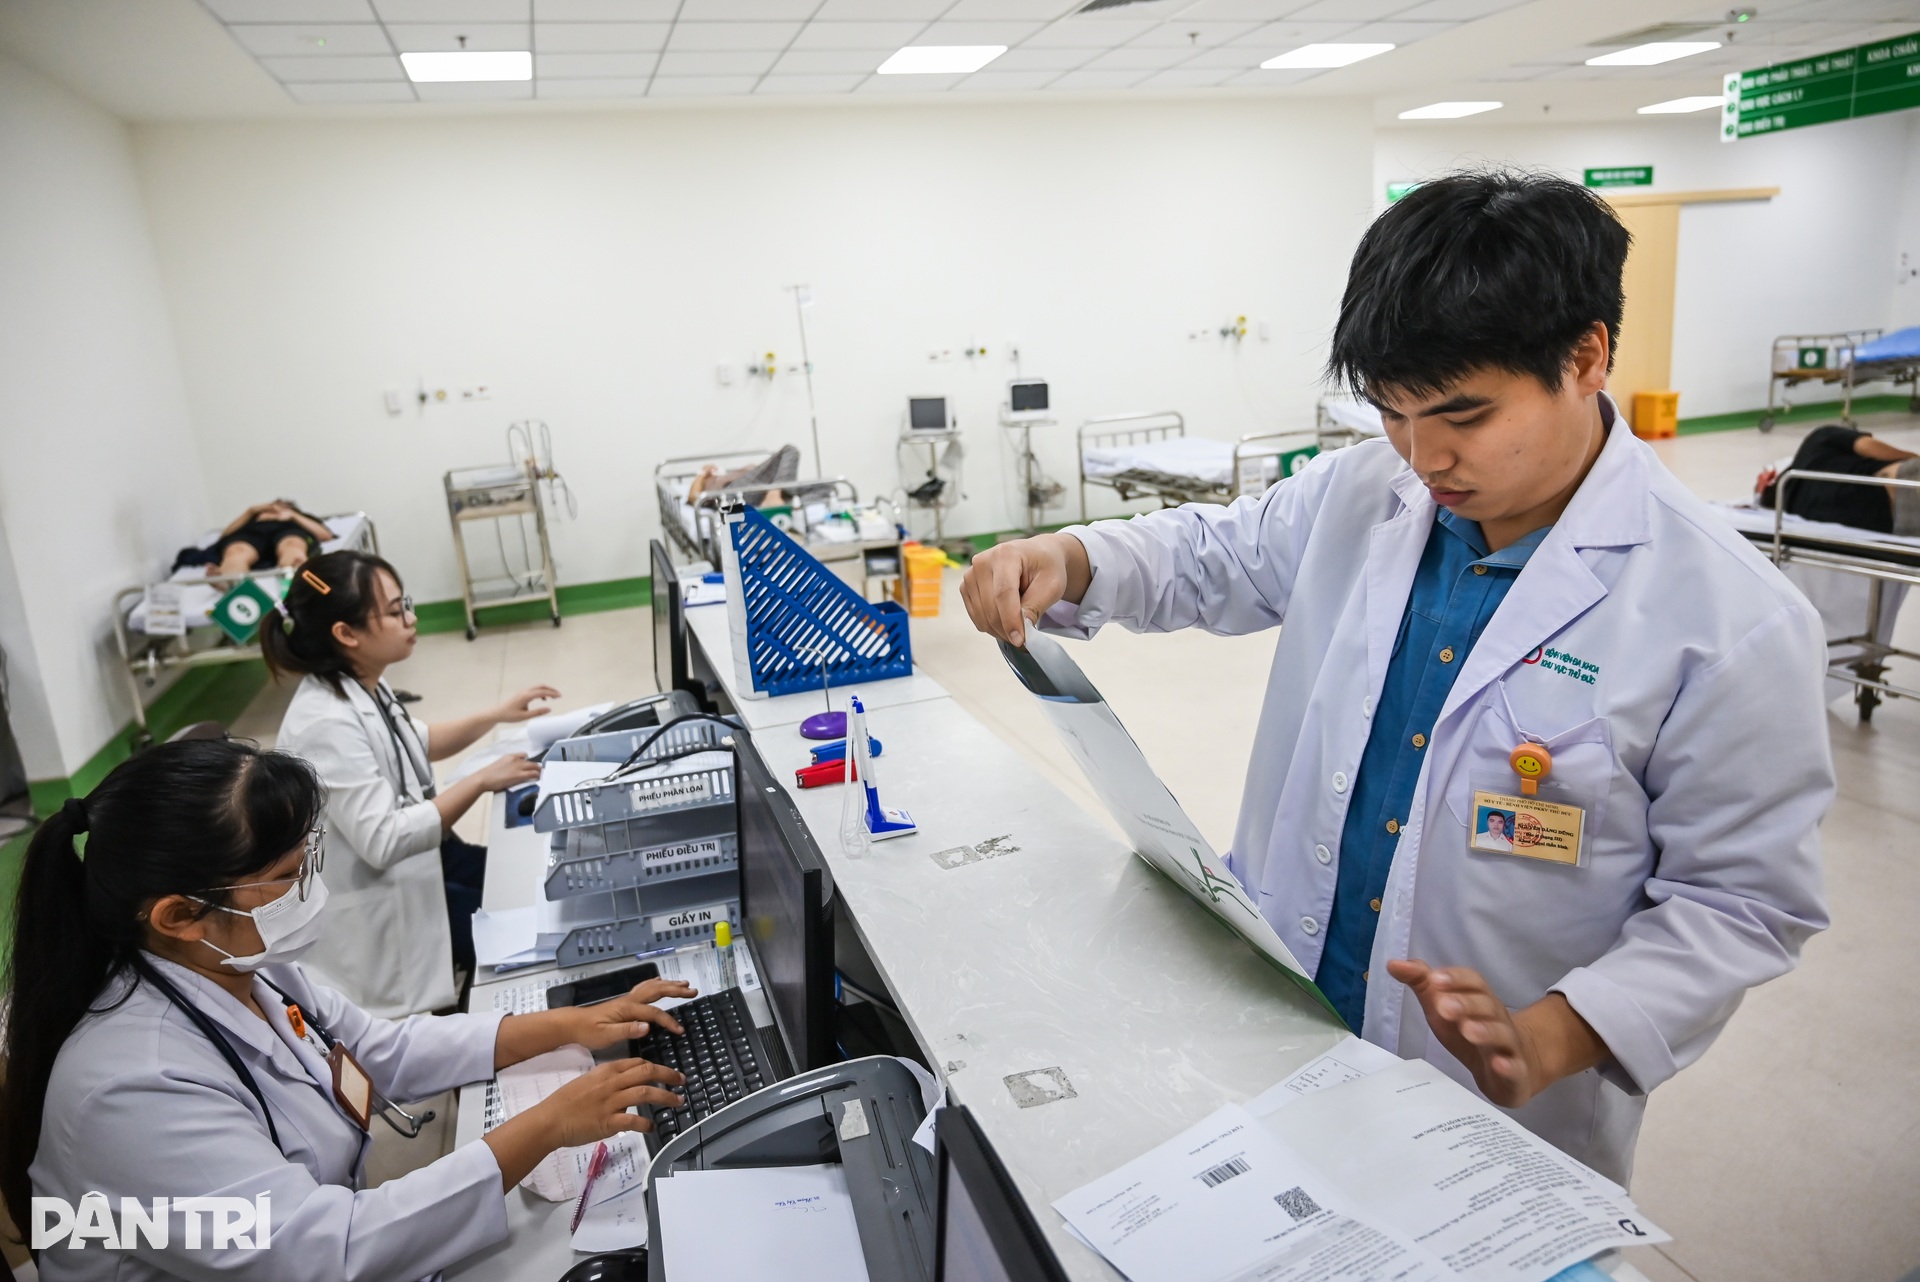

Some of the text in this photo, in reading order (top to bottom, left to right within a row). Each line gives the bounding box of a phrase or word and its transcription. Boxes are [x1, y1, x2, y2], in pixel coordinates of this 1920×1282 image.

[1540, 659, 1553, 670] KHU
[1554, 663, 1568, 675] VỰC
[1567, 668, 1581, 679] THỦ
[1545, 647, 1559, 660] BỆNH
[1559, 652, 1572, 664] VIỆN
[1581, 661, 1599, 674] KHOA
[638, 789, 662, 803] PHIẾU
[645, 841, 716, 861] PHIẾU ĐIỀU TRỊ
[668, 911, 712, 927] GIẤY IN
